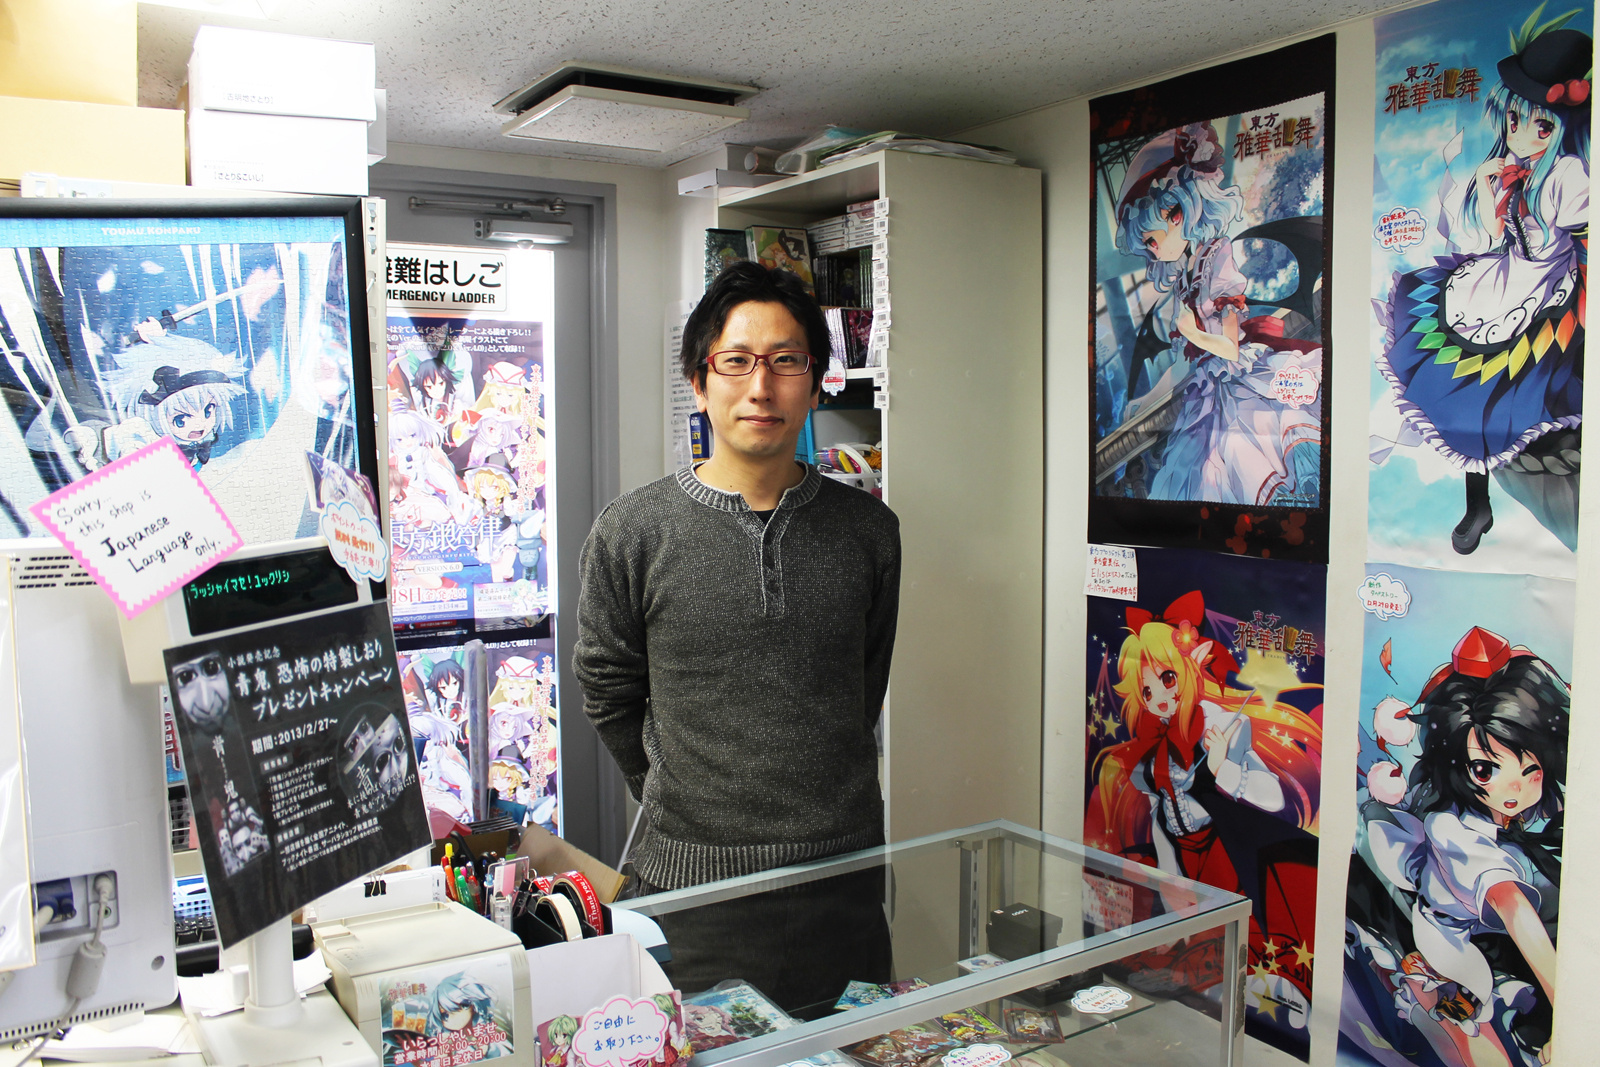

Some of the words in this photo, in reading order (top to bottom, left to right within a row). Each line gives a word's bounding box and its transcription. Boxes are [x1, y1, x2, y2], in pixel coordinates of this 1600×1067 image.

[1404, 62, 1439, 83] 東方
[1384, 68, 1482, 115] 雅華乱舞
[1250, 112, 1279, 131] 東方
[1233, 117, 1315, 162] 雅華乱舞
[101, 227, 144, 235] YOUMU
[146, 226, 201, 235] KONPAKU
[386, 257, 503, 288] 難はしご
[386, 290, 446, 302] MERGENCY
[452, 292, 495, 303] LADDER
[79, 519, 104, 537] this
[109, 501, 134, 519] shop
[141, 490, 152, 501] is
[101, 515, 170, 557] Japanese
[195, 537, 221, 556] only.
[128, 530, 193, 573] Language
[1250, 610, 1281, 628] 東方
[1233, 621, 1317, 666] 雅華乱舞
[235, 669, 270, 697] 青鬼
[277, 639, 382, 684] 恐怖の特製しおり
[253, 667, 392, 721] プレゼントキャンペーン
[403, 1022, 498, 1051] いらっしゃいませ
[594, 1015, 635, 1030] ご自由に
[594, 1034, 659, 1051] お取り下さい。
